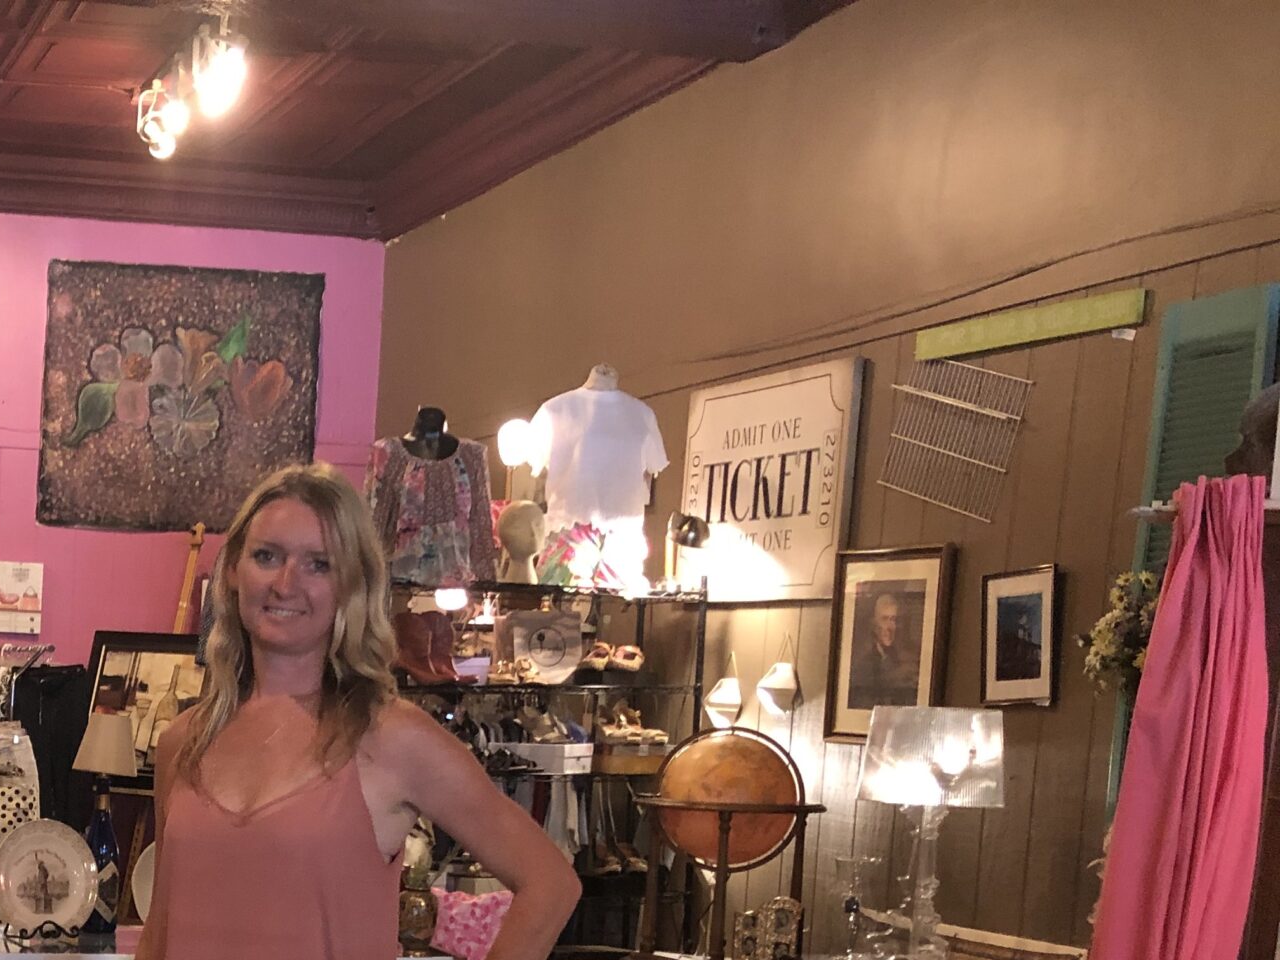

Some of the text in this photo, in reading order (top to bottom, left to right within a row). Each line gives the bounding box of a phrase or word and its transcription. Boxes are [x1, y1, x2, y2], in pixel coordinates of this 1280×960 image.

[723, 418, 802, 450] ADMIT ONE
[688, 454, 701, 515] 3210
[703, 447, 820, 524] TICKET
[819, 433, 836, 527] 273210
[762, 528, 793, 552] ONE
